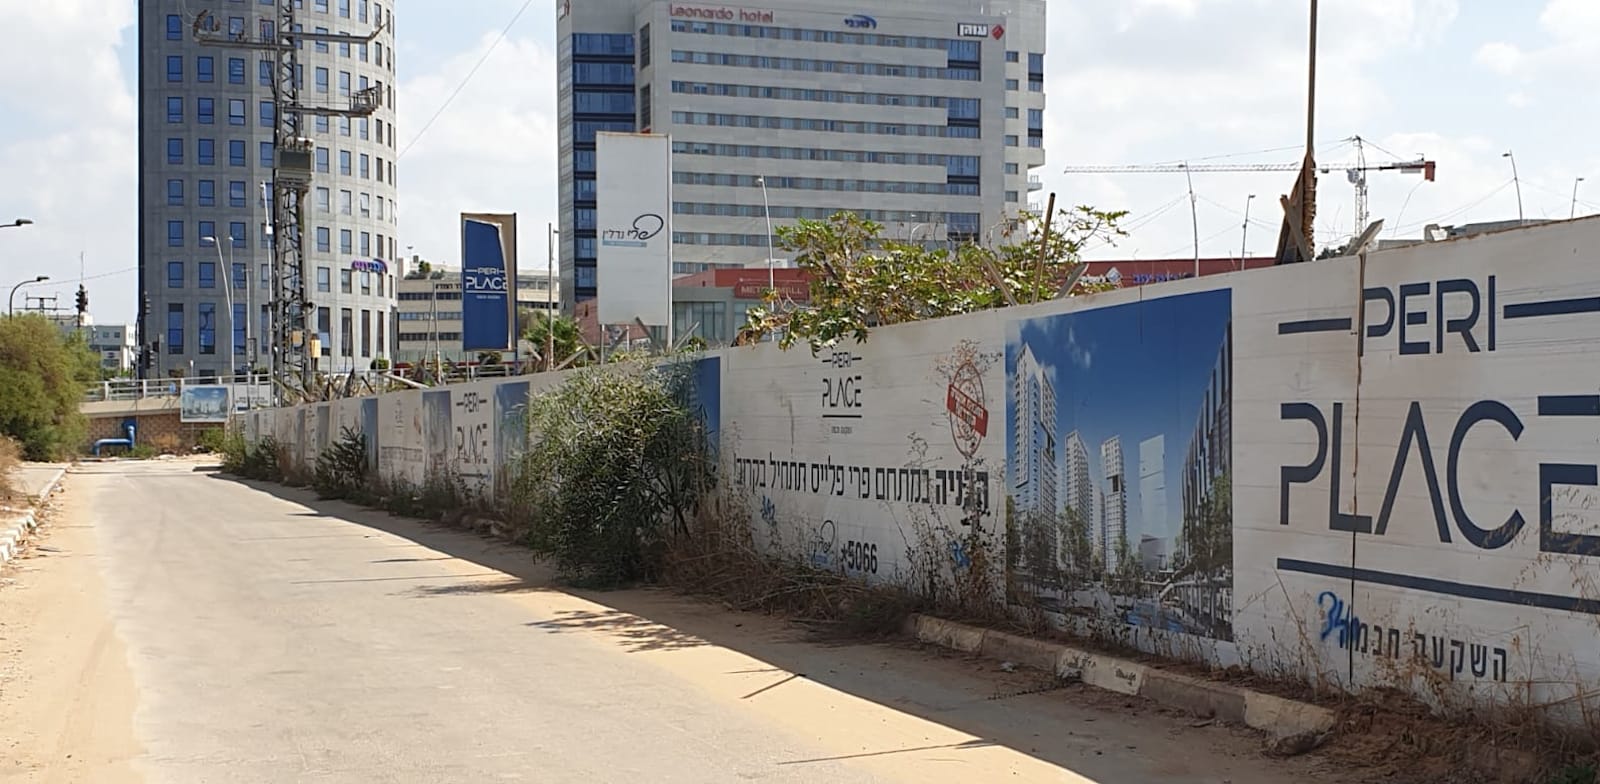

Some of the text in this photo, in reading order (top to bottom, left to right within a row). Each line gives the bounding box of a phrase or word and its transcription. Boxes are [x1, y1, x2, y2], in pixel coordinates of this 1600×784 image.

[670, 3, 774, 23] Leonardo hotel
[465, 277, 508, 289] PLACE
[477, 267, 499, 275] PERI
[1360, 275, 1497, 357] PERI
[831, 352, 852, 369] PERI
[463, 391, 480, 413] PERI
[822, 375, 862, 408] PLACE
[769, 451, 807, 492] תתחיל
[810, 455, 846, 497] פלייס
[848, 465, 871, 499] פרי
[875, 467, 931, 504] במתחם
[1280, 395, 1600, 557] PLACE
[1414, 631, 1507, 683] השקעה
